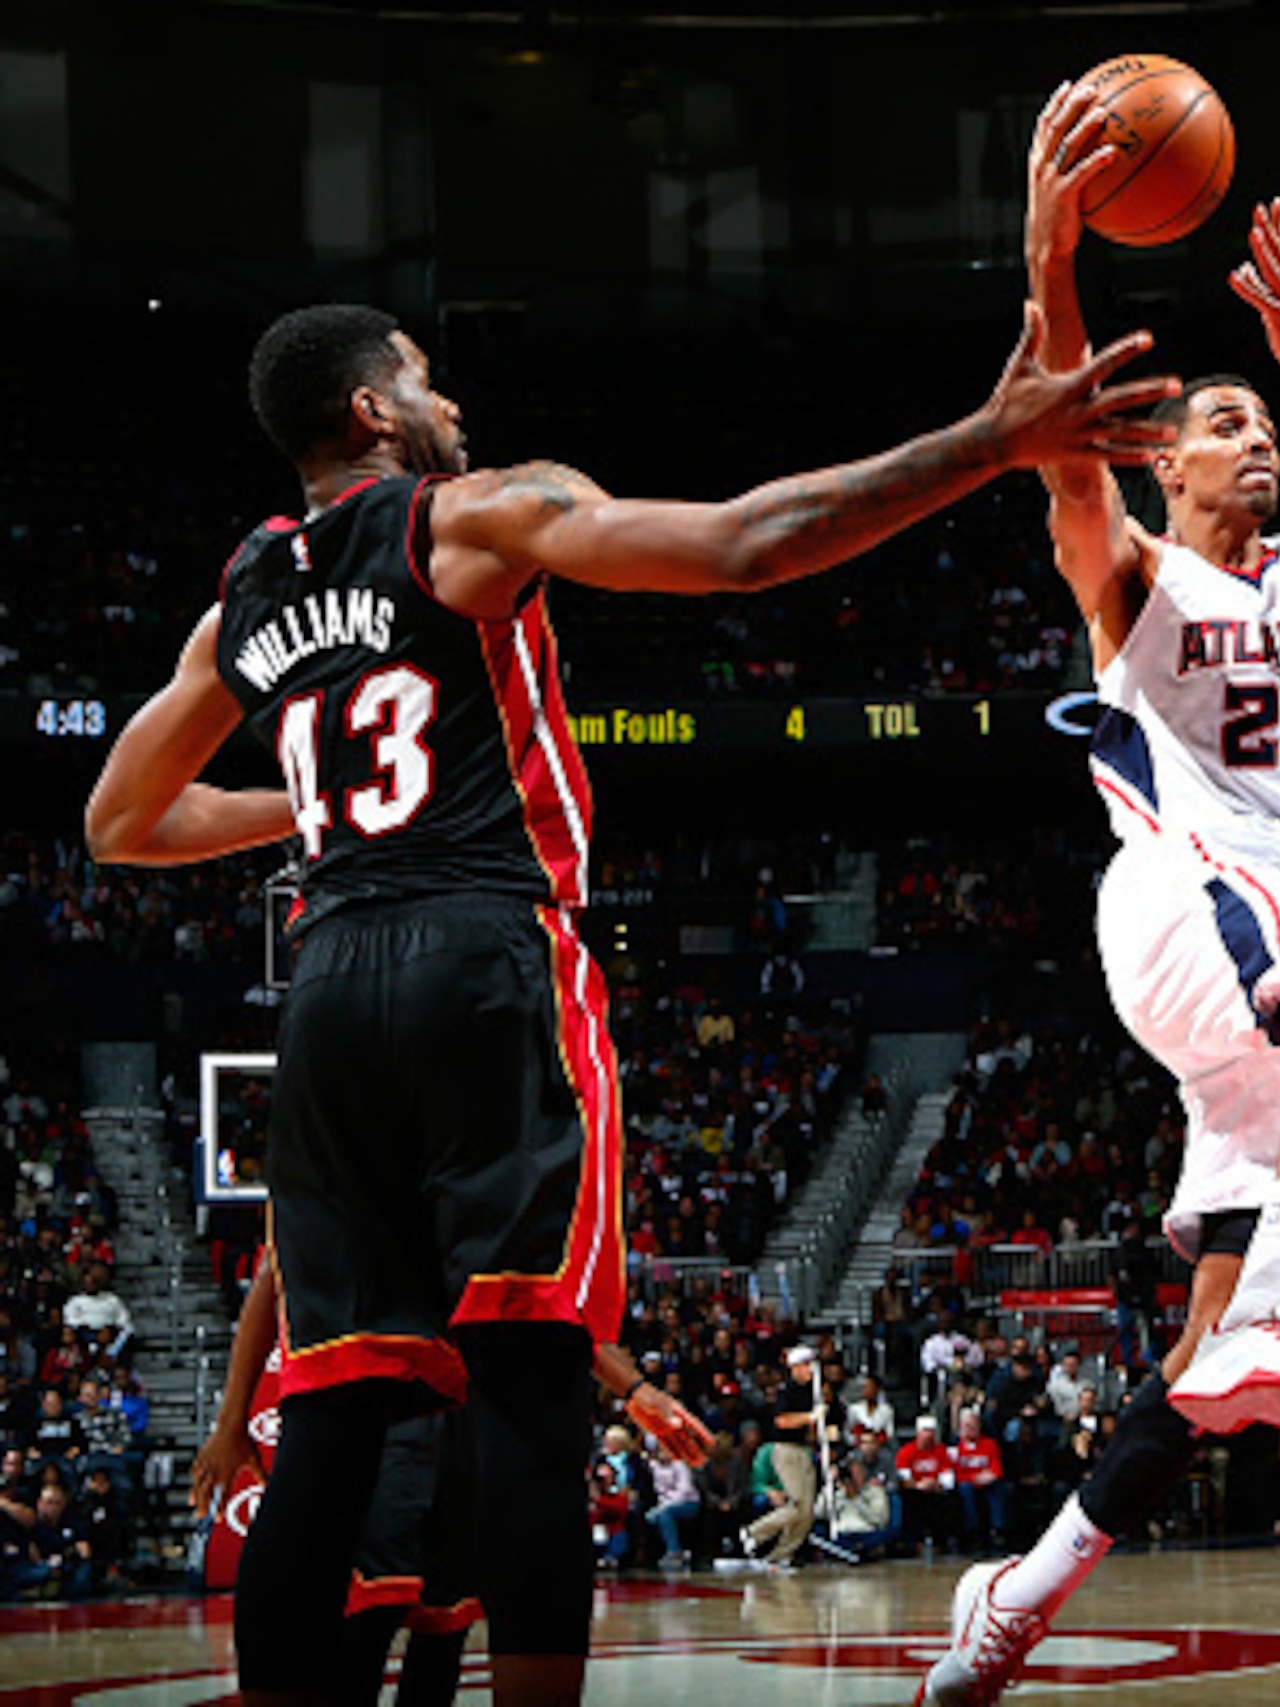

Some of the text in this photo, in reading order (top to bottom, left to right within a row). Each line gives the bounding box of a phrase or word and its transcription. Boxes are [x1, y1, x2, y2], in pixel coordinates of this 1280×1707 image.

[235, 588, 395, 692] WILLIAMS
[36, 701, 106, 736] 4:43
[612, 708, 696, 744] Fouls
[786, 707, 806, 741] 4
[866, 704, 920, 739] TOL
[972, 699, 992, 735] 1
[277, 662, 440, 860] 43
